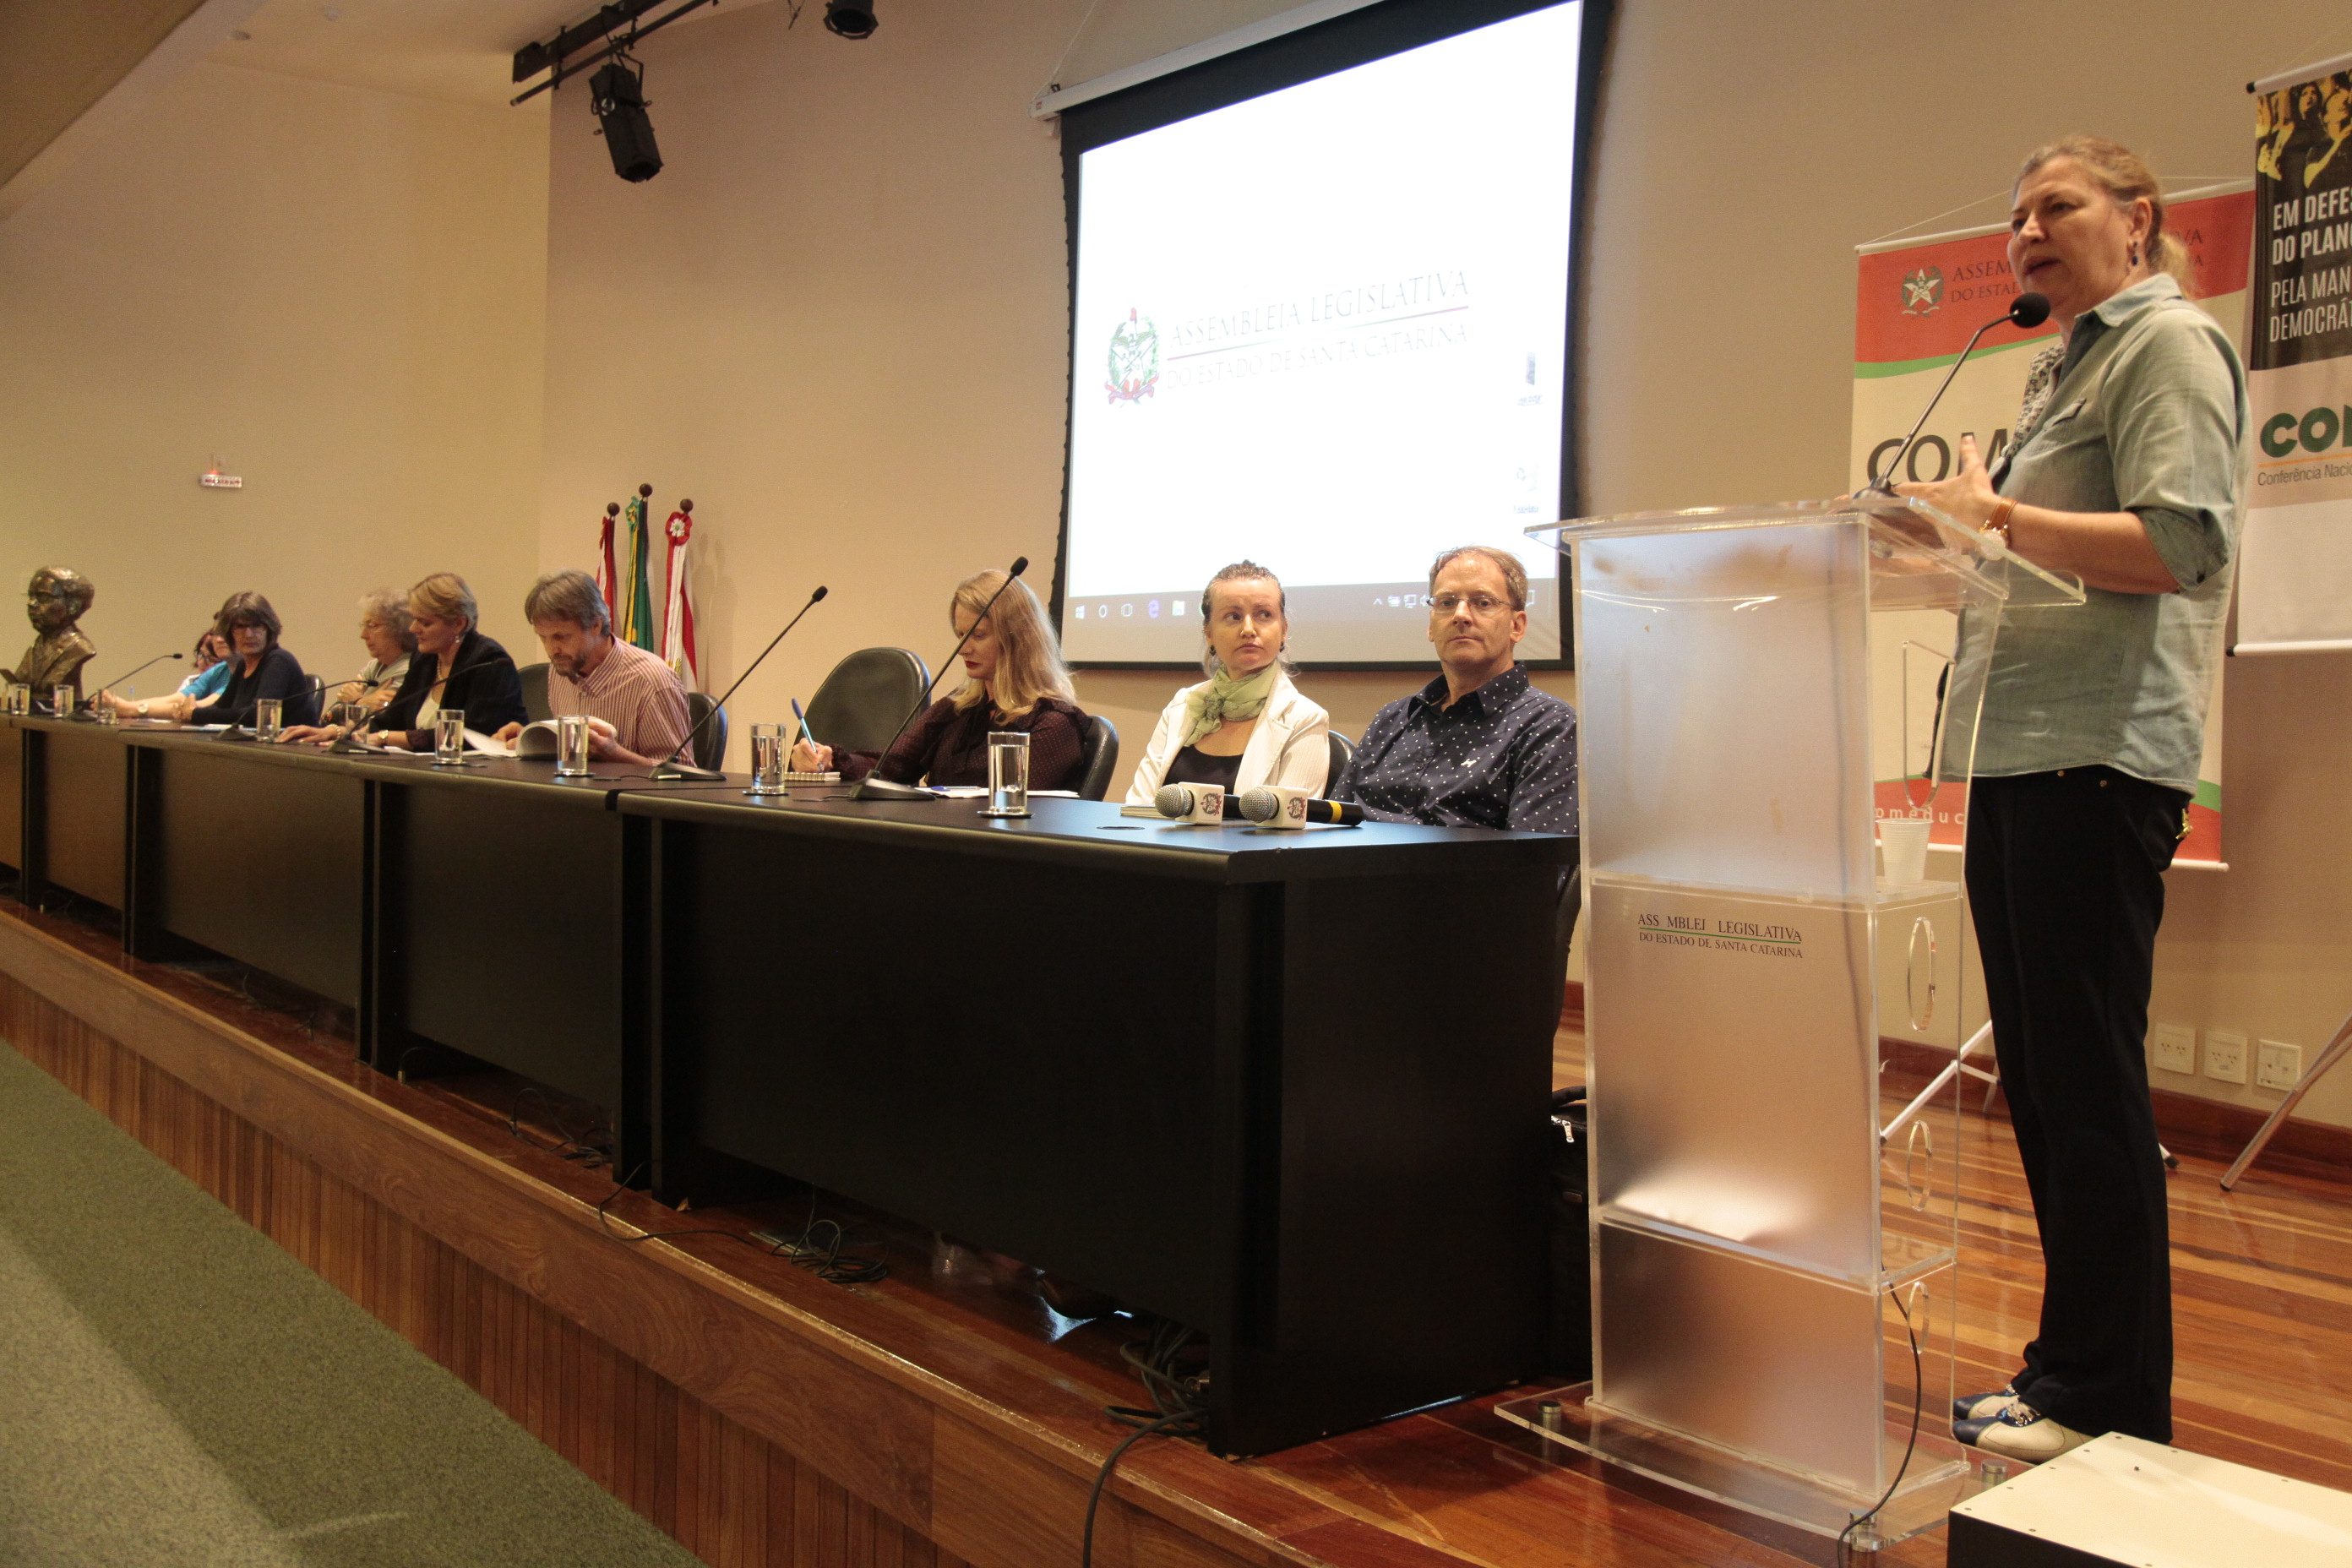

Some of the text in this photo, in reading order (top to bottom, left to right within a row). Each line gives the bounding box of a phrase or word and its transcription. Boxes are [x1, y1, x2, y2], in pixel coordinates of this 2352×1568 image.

[2273, 186, 2352, 231] EM DEFE
[2272, 221, 2352, 265] DO PLAN
[1951, 288, 1974, 303] DO
[2271, 275, 2307, 308] PELA
[1169, 270, 1469, 349] ASSEMBLEIA LEGISLATIVA
[1167, 322, 1468, 389] DO ESTADO DE SANTA CATARINA
[2257, 466, 2322, 487] Conferência
[1639, 932, 1804, 958] DO ESTADO DE SANTA CATARINA
[1718, 920, 1803, 942] LEGISLATIVA
